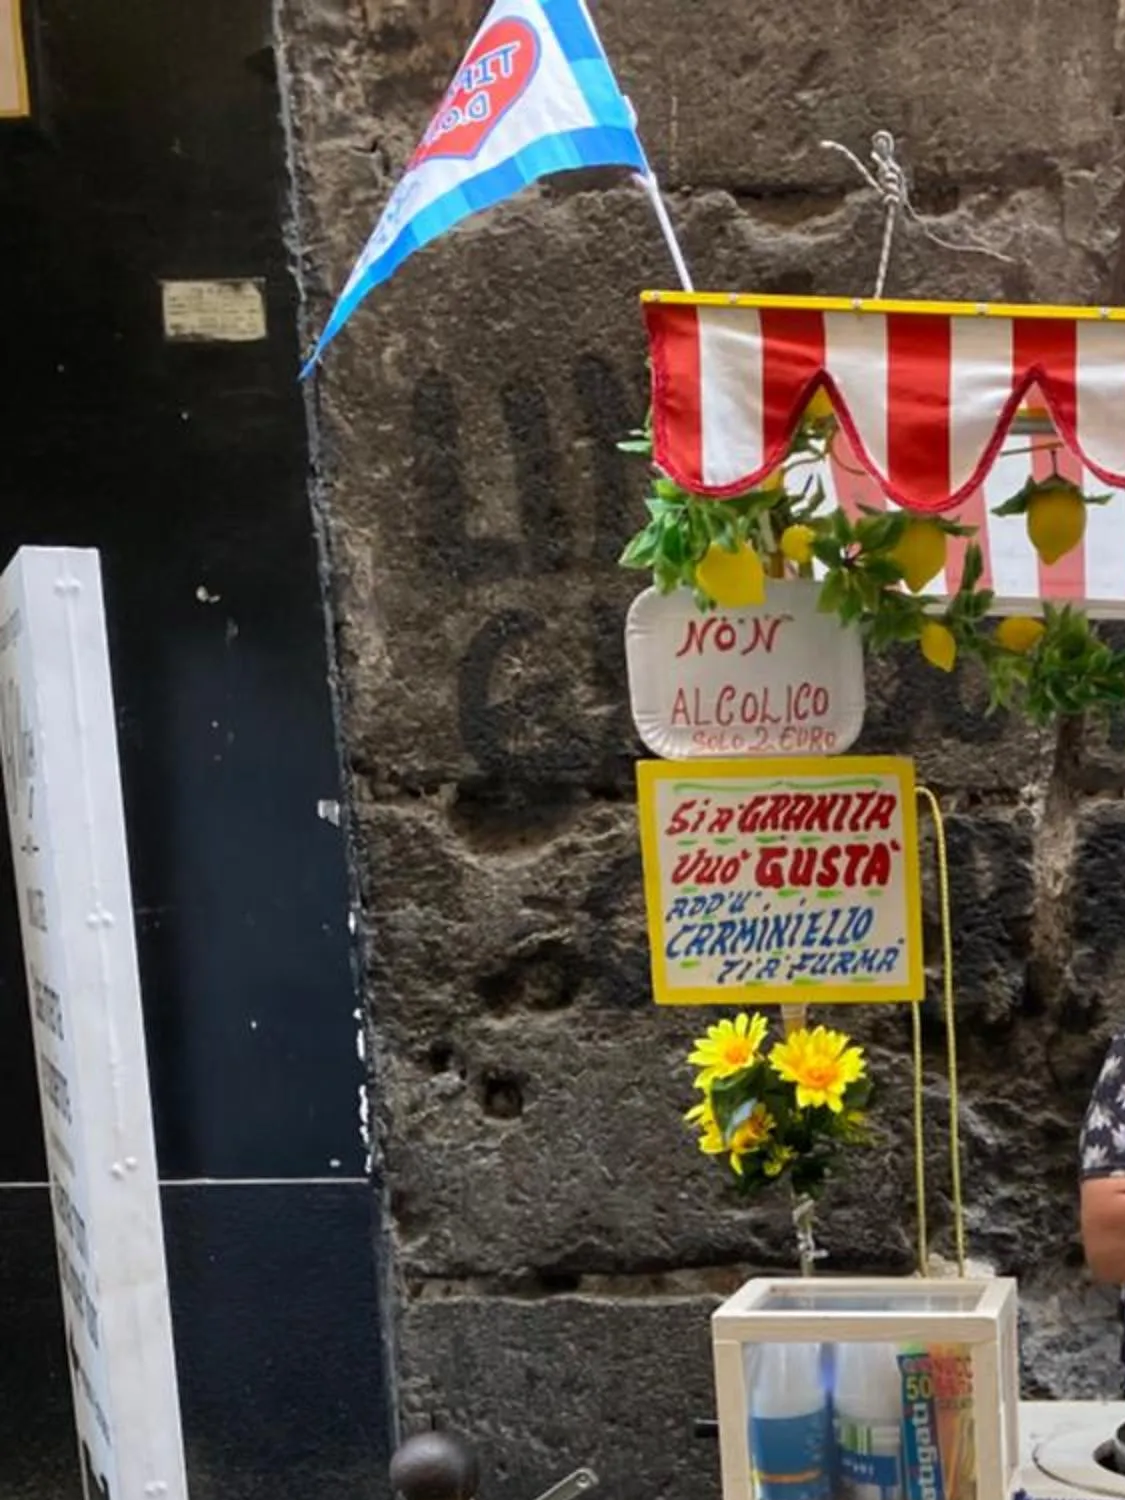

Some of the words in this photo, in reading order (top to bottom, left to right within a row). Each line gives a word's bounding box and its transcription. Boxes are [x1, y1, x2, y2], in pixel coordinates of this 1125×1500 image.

[676, 616, 783, 657] NON
[671, 682, 829, 727] ALCOLICO
[693, 730, 744, 750] SOLO
[738, 791, 897, 833] GRANITA
[665, 897, 875, 958] CARMINIELLO
[906, 1375, 933, 1401] 50
